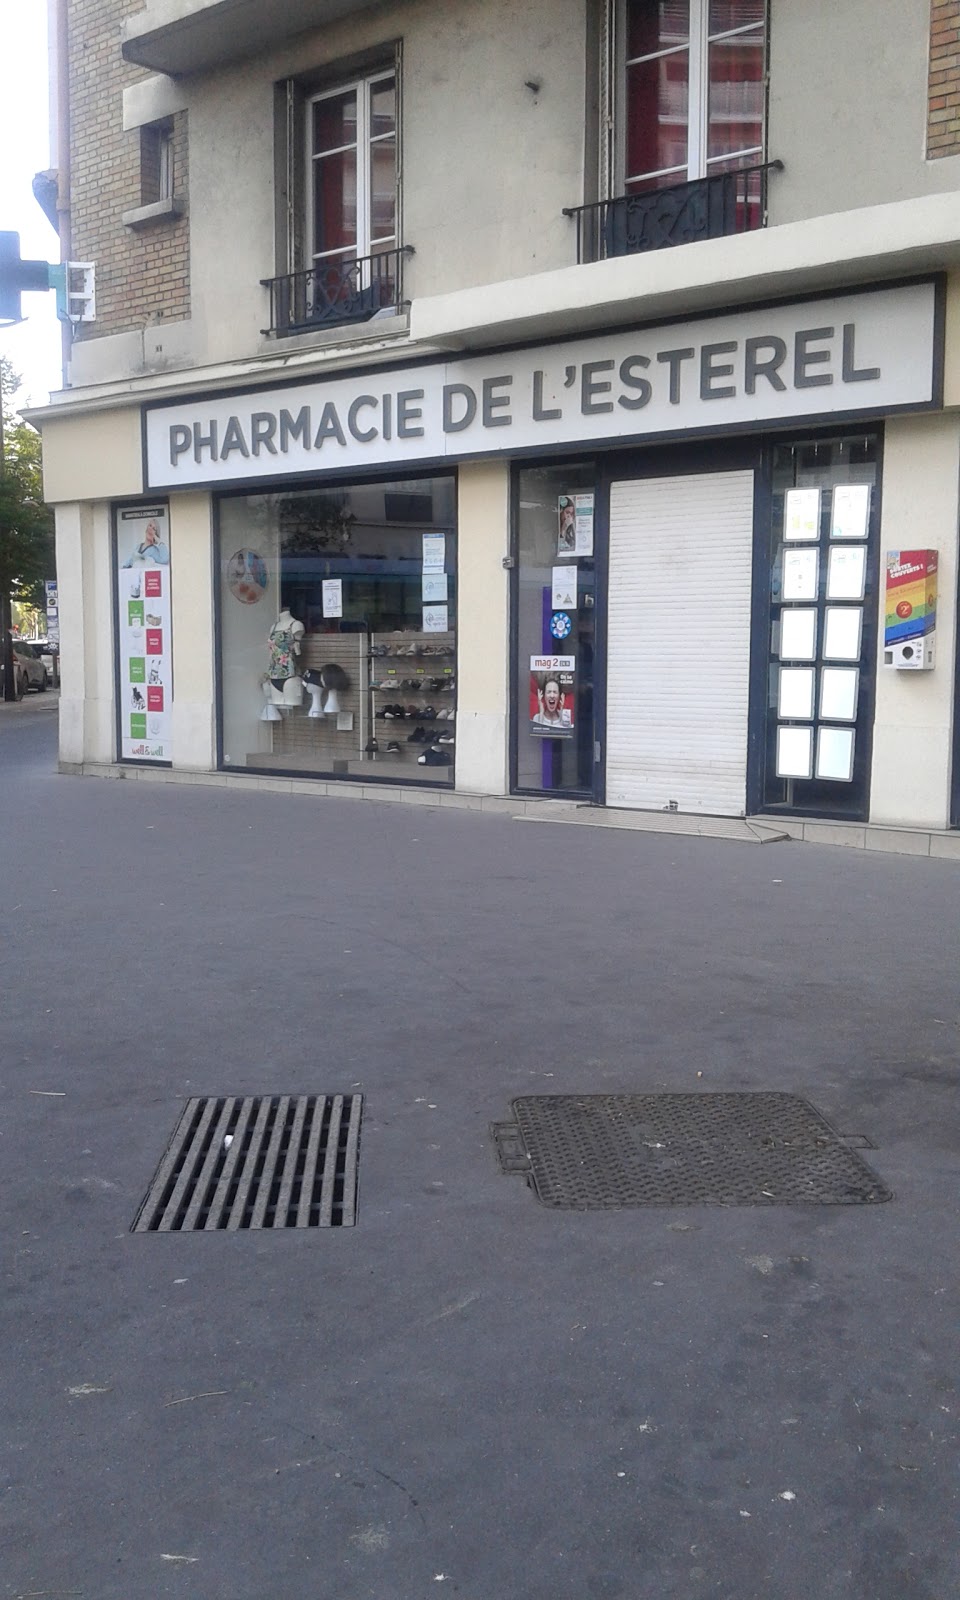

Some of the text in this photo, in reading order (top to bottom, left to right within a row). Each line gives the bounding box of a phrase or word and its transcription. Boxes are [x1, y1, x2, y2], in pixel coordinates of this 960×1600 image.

[169, 323, 881, 467] PHARMACIE DE L'ESTEREL
[535, 659, 551, 670] mag
[553, 658, 558, 667] 2
